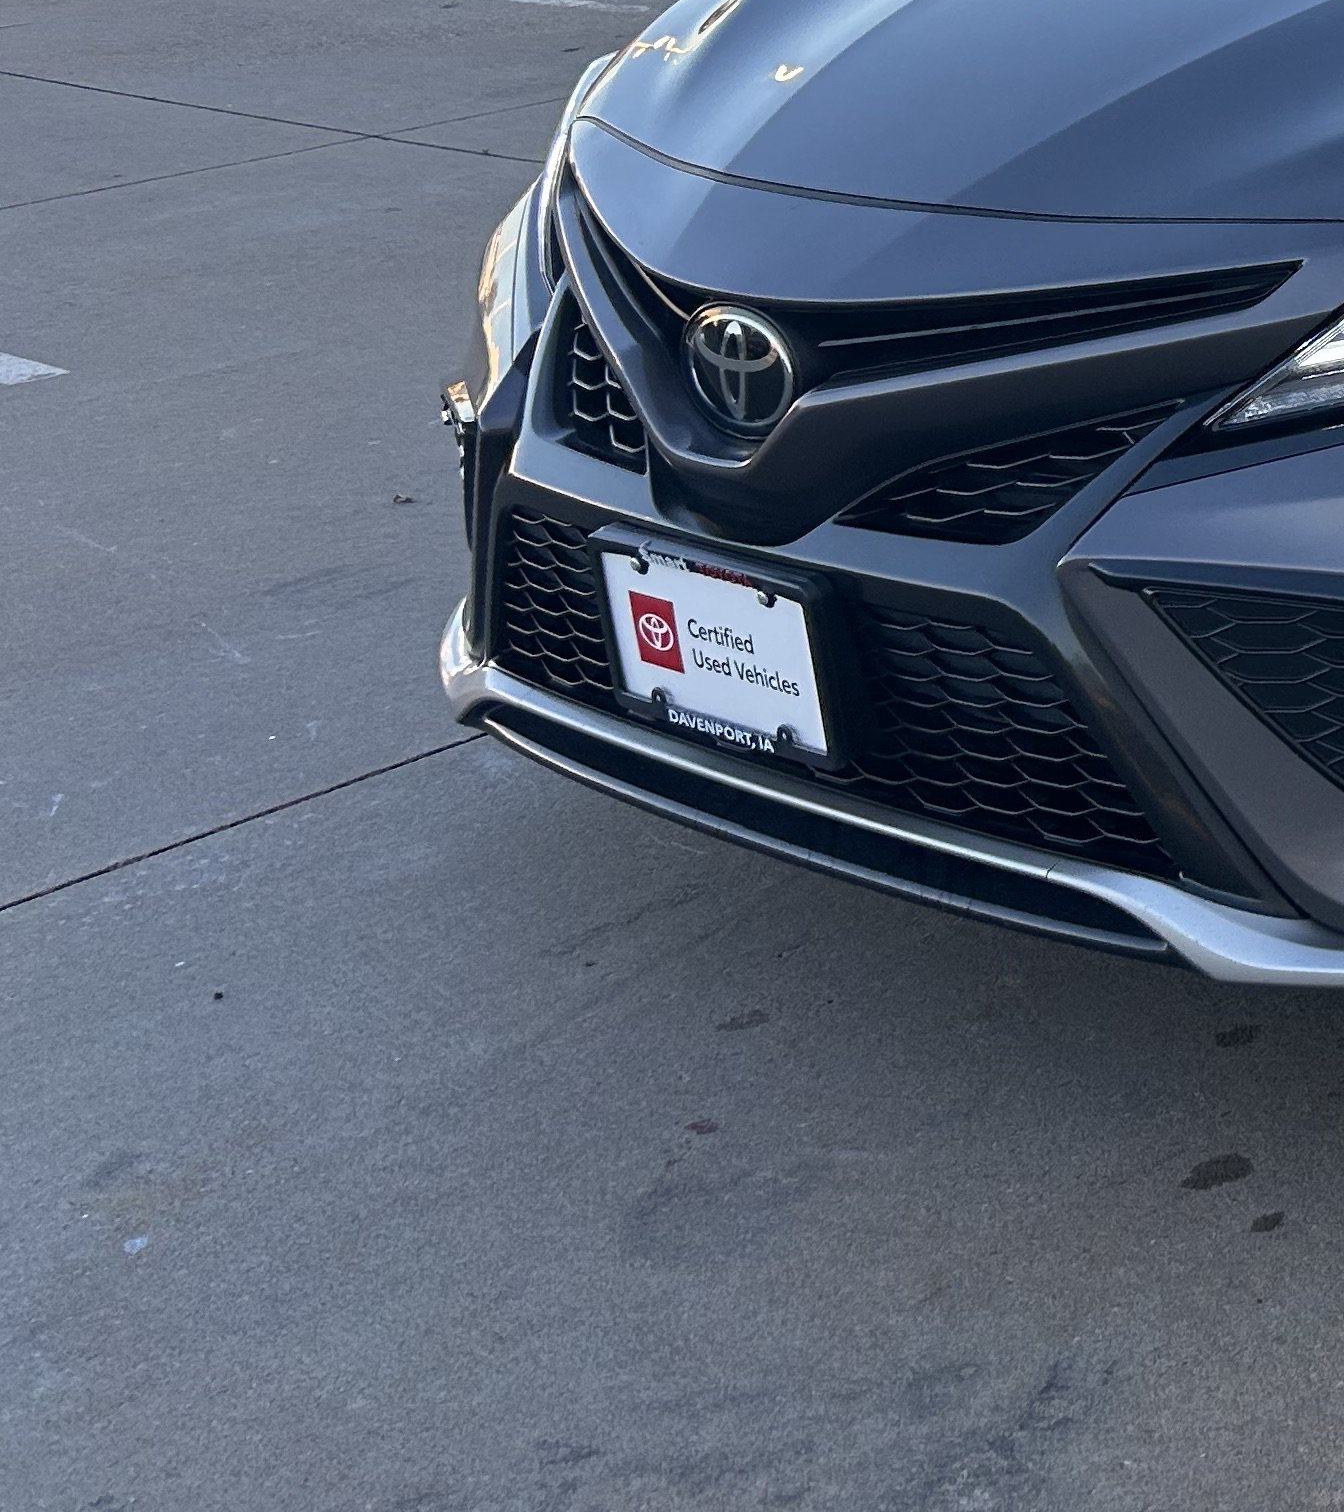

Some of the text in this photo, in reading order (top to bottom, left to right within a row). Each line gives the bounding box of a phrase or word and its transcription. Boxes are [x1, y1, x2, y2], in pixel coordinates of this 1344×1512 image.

[638, 539, 690, 573] Smart
[687, 618, 755, 655] Certified
[692, 648, 800, 697] Used Vehicles
[668, 708, 775, 754] DAVENPORT, IA
